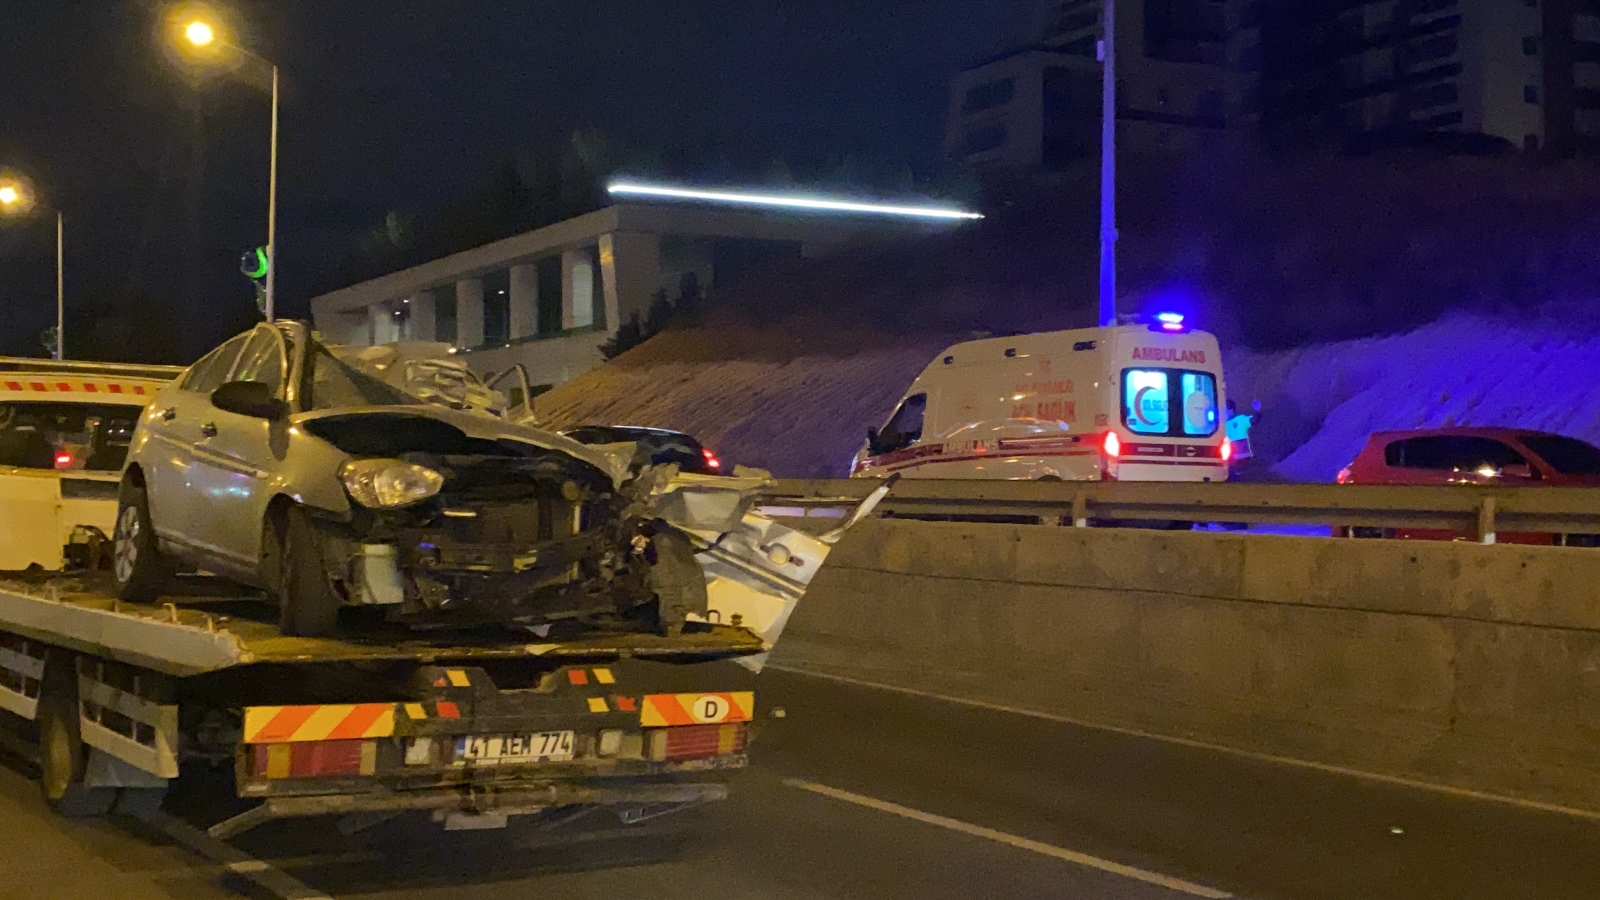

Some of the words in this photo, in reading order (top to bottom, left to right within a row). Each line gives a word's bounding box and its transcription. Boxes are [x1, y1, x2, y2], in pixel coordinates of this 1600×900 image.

[1132, 347, 1206, 364] AMBULANS
[704, 701, 718, 719] D
[470, 737, 489, 757] 41
[541, 732, 570, 754] 774
